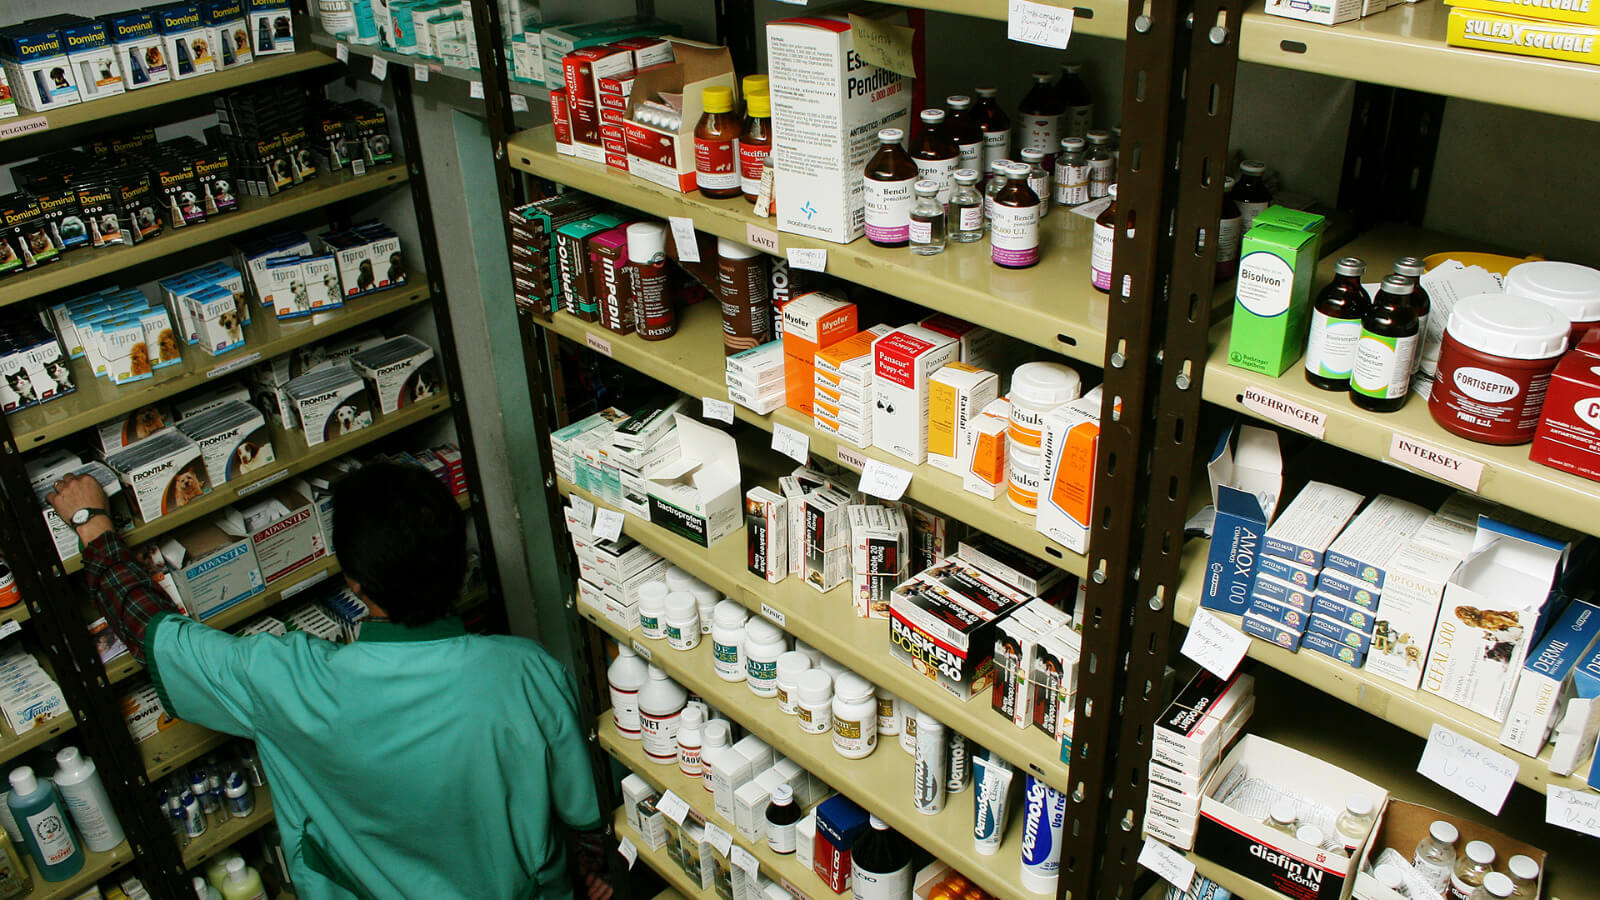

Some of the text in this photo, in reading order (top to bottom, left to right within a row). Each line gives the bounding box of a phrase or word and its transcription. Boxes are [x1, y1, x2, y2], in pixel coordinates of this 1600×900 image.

[165, 13, 200, 27] Dominal
[212, 5, 241, 18] Dominal
[118, 21, 153, 35] Dominal
[1464, 18, 1593, 53] SULFAX SOLUBLE
[68, 31, 106, 46] Dominal
[20, 40, 59, 55] Dominal
[600, 81, 620, 92] Coccifin
[602, 96, 624, 107] Coccifin
[1, 121, 47, 136] PULGUICIDAS
[601, 127, 622, 138] Coccifin
[625, 126, 646, 140] Coccifin
[606, 142, 626, 153] Coccifin
[196, 159, 229, 173] Dominal
[607, 156, 627, 168] Coccifin
[160, 170, 195, 185] Dominal
[80, 193, 112, 206] Domin
[883, 187, 907, 196] Bencil
[41, 194, 76, 210] Dominal
[6, 207, 40, 224] Dominal
[372, 242, 394, 257] fipro
[752, 234, 776, 249] LAVET
[342, 249, 364, 264] fipro
[272, 268, 296, 284] fipro
[305, 261, 329, 277] fipro
[557, 235, 576, 316] HEPATIOC
[1241, 268, 1281, 288] Bisolvon
[602, 257, 622, 331] IMPEDIL
[207, 300, 231, 316] fipro
[784, 312, 810, 329] Myofer
[822, 315, 848, 331] Myofer
[109, 331, 137, 348] fipro
[27, 348, 55, 366] fipro
[1242, 353, 1269, 366] Boehringer
[377, 360, 412, 377] FRONTLINE
[817, 360, 837, 373] Panacur
[817, 377, 837, 390] Panacur
[1456, 372, 1514, 396] FORTISEPTIN
[300, 391, 339, 408] FRONTLINE
[817, 392, 837, 405] Panacur
[816, 407, 836, 420] Panacur
[1010, 404, 1044, 426] Trisuls
[1244, 390, 1320, 426] BOEHRINGER
[817, 421, 837, 434] Panacur
[200, 429, 239, 448] FRONTLINE
[1044, 431, 1055, 483] Vetalgina
[1399, 440, 1463, 471] INTERSEY
[133, 461, 173, 482] FRONTLINE
[657, 499, 702, 527] bactroprofen
[264, 510, 311, 538] ADVANTIX
[197, 544, 248, 576] ADVANTIX
[1228, 526, 1259, 606] AMOX 100
[956, 571, 980, 591] basken
[926, 588, 980, 624] basken doble 40
[890, 616, 969, 671] BASKEN
[891, 631, 962, 684] DOBLE 40
[1426, 620, 1457, 693] CEFAL 500
[1533, 639, 1570, 673] DERMIL
[129, 704, 159, 724] POWER
[1179, 697, 1206, 732] cestodan
[681, 755, 702, 767] KAOV
[1051, 791, 1069, 830] Uso Frec
[832, 850, 841, 891] CALCIO
[1249, 842, 1324, 885] diafin N
[1287, 870, 1320, 893] König
[1452, 887, 1471, 900] diaf
